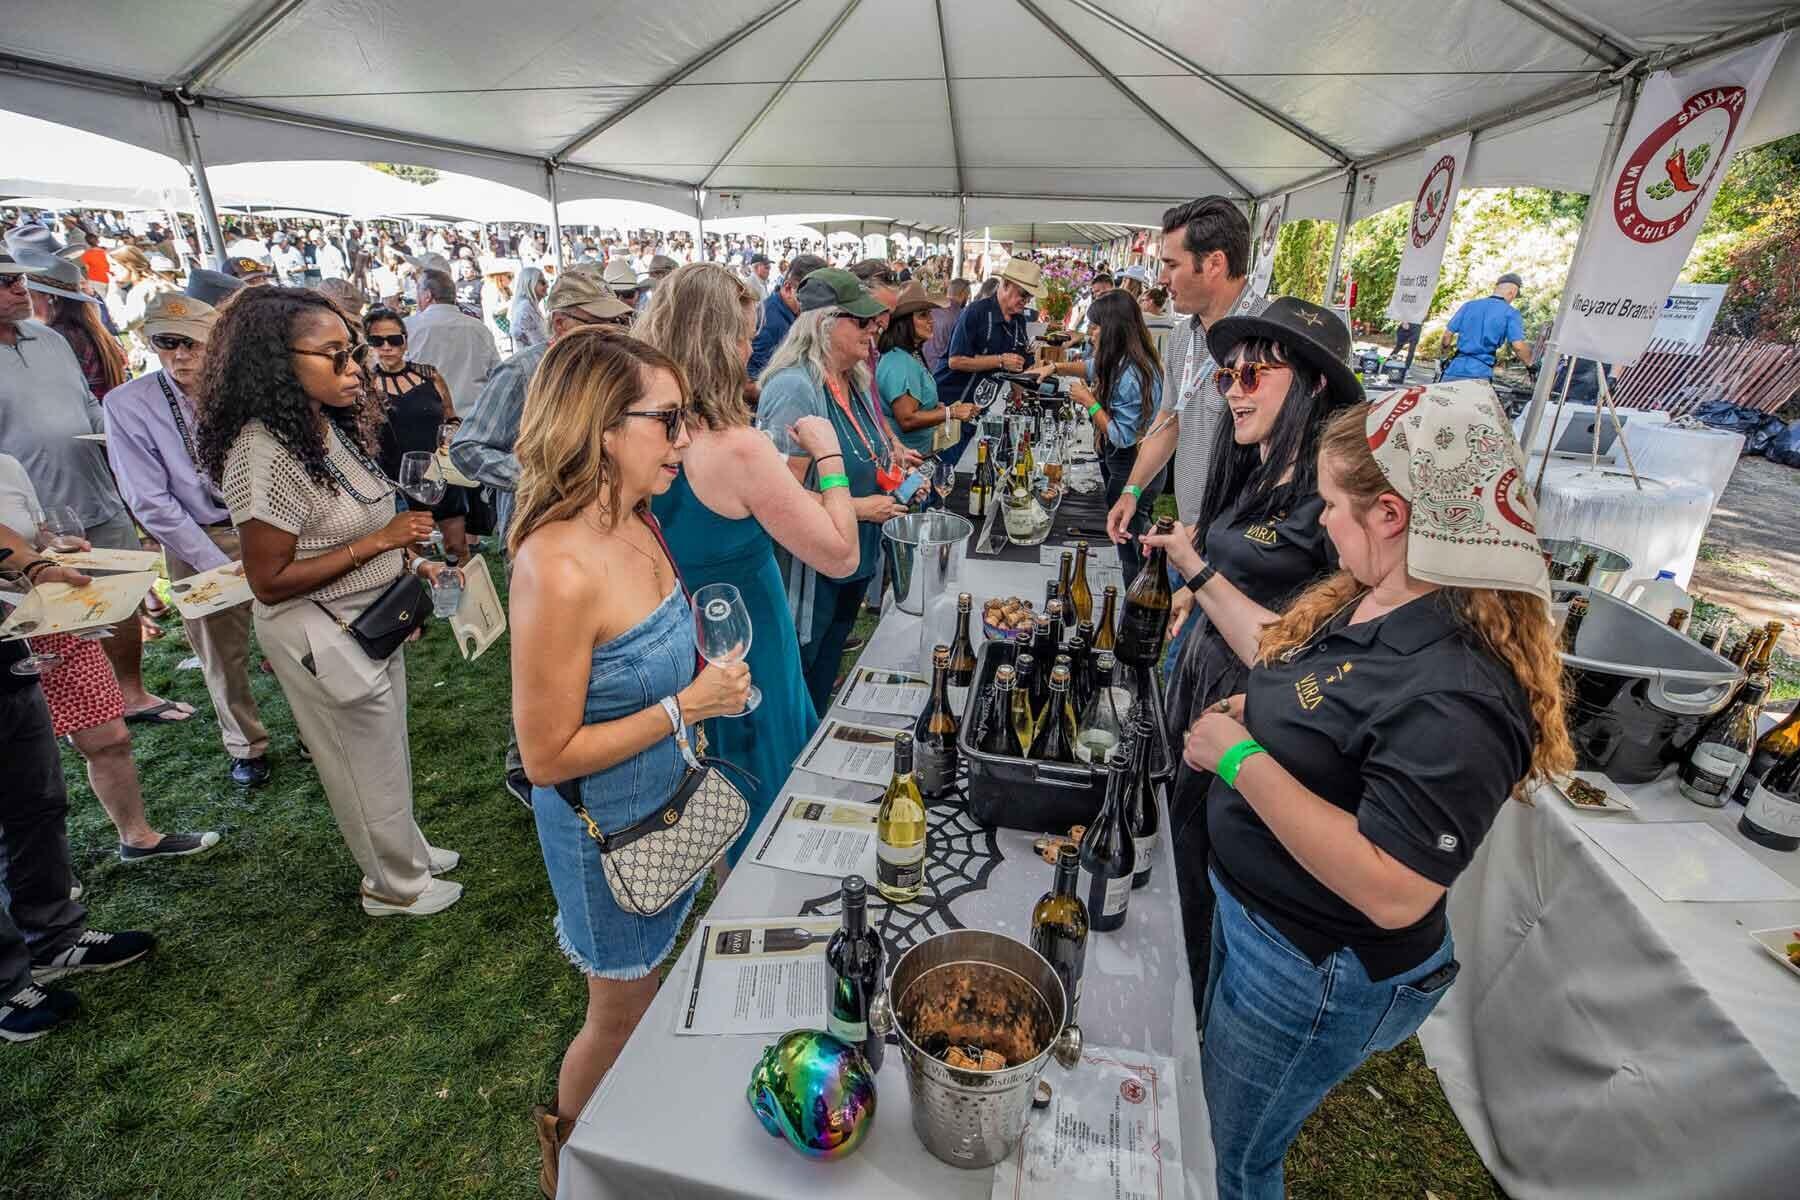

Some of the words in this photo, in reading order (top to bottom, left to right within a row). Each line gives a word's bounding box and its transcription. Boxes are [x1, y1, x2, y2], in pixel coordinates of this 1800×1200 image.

[1677, 90, 1725, 125] SANTA
[1619, 165, 1643, 211] WINE
[1633, 221, 1677, 240] CHILE
[1572, 294, 1621, 317] Vineyard
[1383, 399, 1414, 431] CHILE
